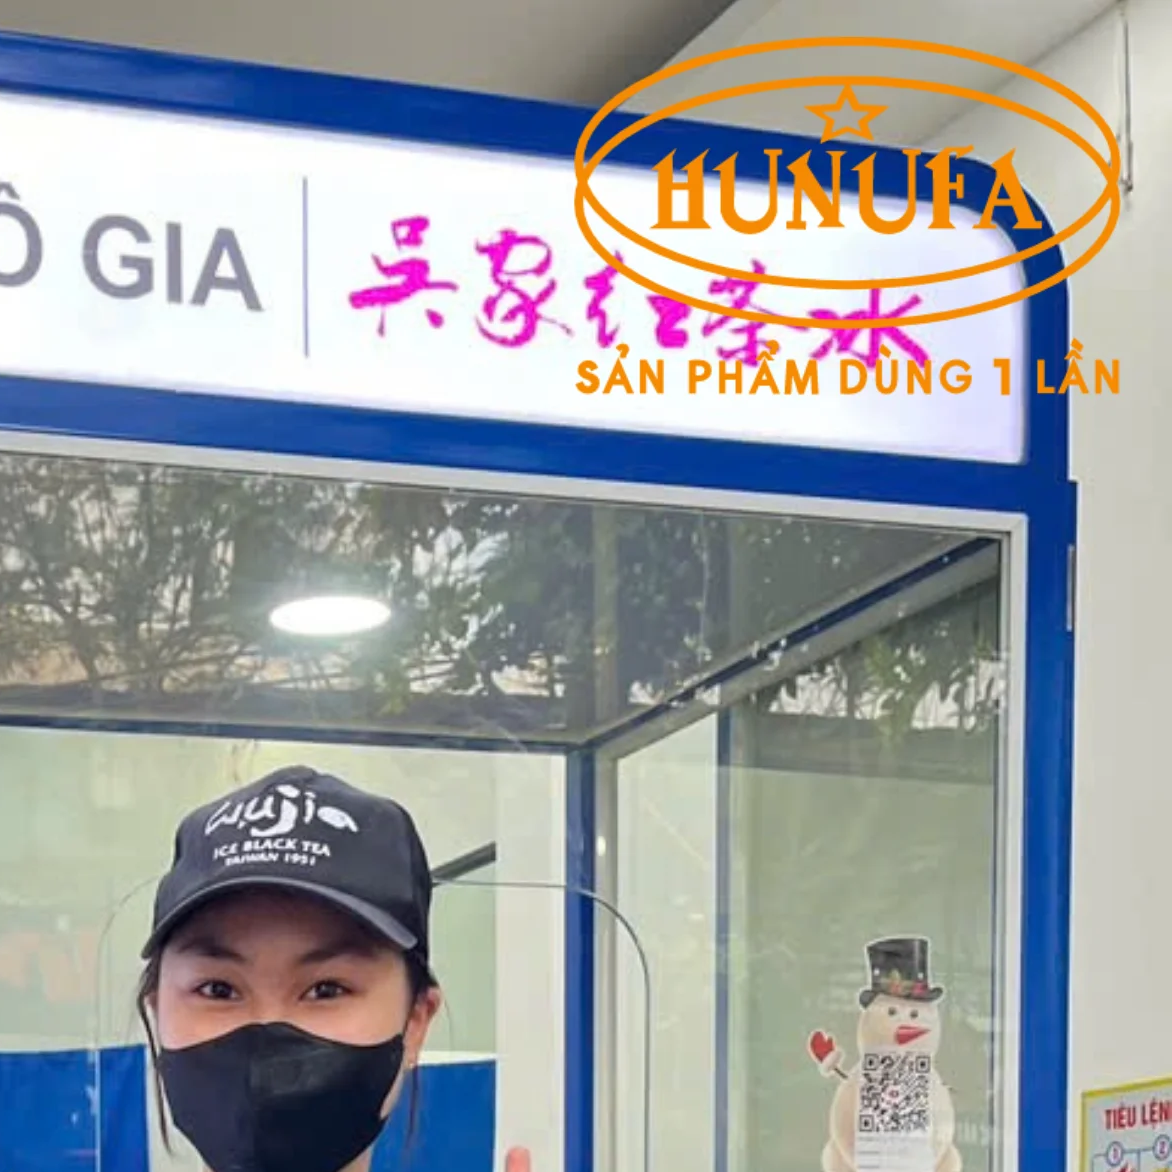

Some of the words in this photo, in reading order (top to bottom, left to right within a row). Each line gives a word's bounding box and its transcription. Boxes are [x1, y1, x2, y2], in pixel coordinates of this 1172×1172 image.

[81, 214, 264, 312] GIA
[214, 845, 239, 859] ICE
[244, 839, 296, 851] BLACK
[302, 840, 331, 856] TEA
[225, 852, 278, 866] TAIWAN
[284, 851, 316, 866] 1951
[1142, 1096, 1172, 1130] LỆN
